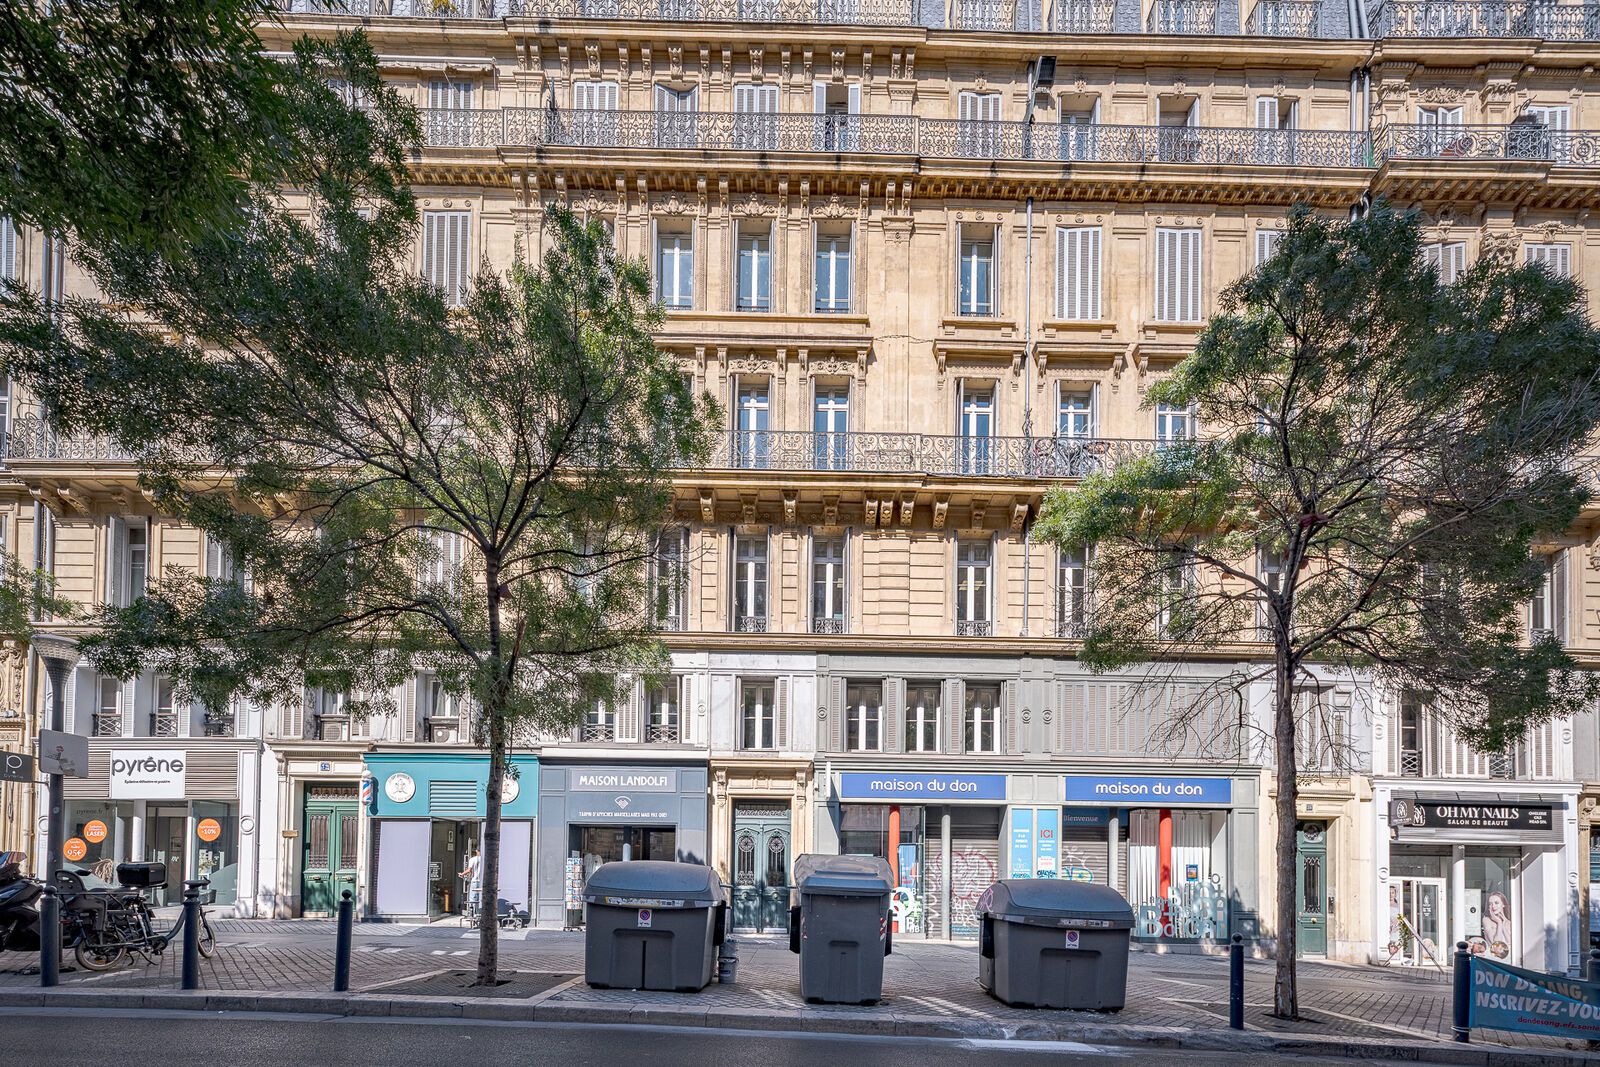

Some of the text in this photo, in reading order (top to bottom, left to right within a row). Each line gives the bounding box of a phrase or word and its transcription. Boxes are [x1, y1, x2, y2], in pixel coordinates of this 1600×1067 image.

[579, 775, 668, 787] MAISON LANDOLFI
[870, 778, 977, 792] maison du don
[1095, 782, 1203, 796] maison du don
[1436, 806, 1457, 818] OH
[1459, 806, 1482, 819] MY
[1482, 807, 1519, 820] NAILS
[1040, 829, 1054, 839] ICI
[1475, 969, 1510, 988] DON
[1515, 977, 1539, 993] DE
